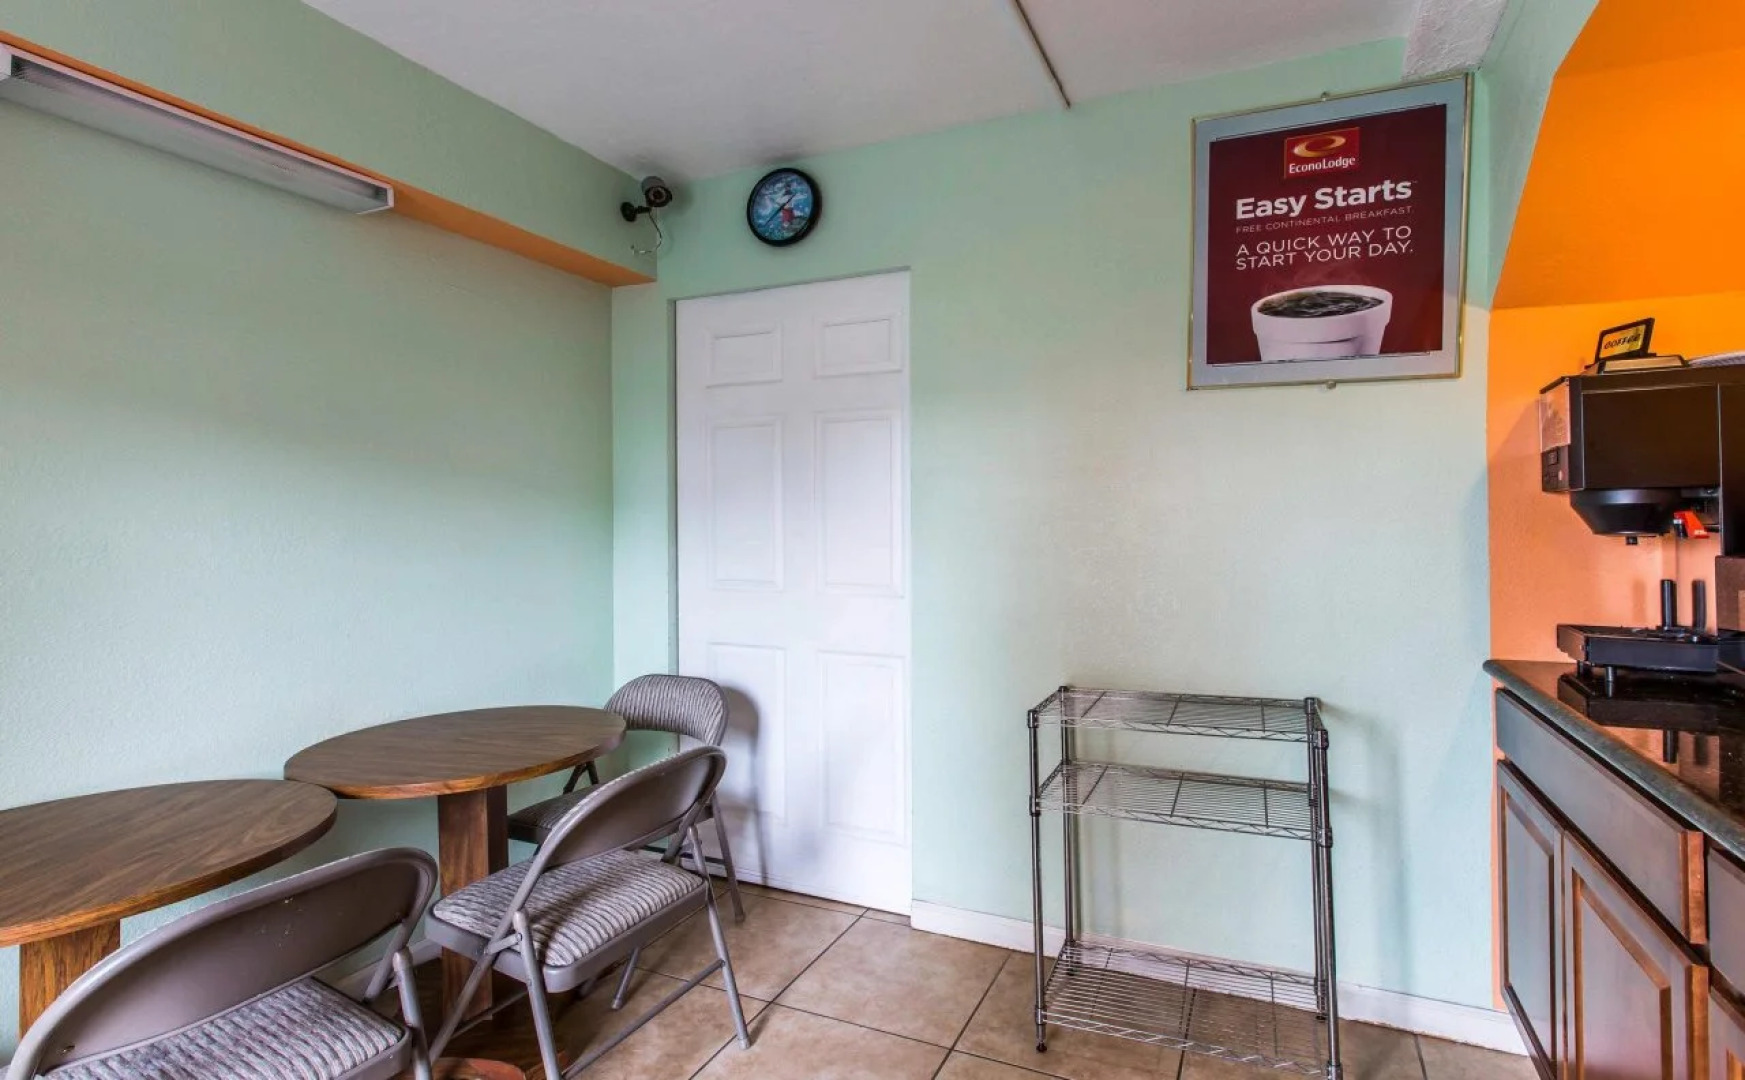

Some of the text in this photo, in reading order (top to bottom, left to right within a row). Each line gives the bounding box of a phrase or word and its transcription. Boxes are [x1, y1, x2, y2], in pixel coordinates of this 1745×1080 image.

[1236, 179, 1412, 220] Easy Starts
[1236, 225, 1262, 234] FREE
[1265, 216, 1341, 230] CONTINENTAL
[1236, 225, 1412, 257] A QUICK WAY TO
[1236, 240, 1414, 271] START YOUR DAY.
